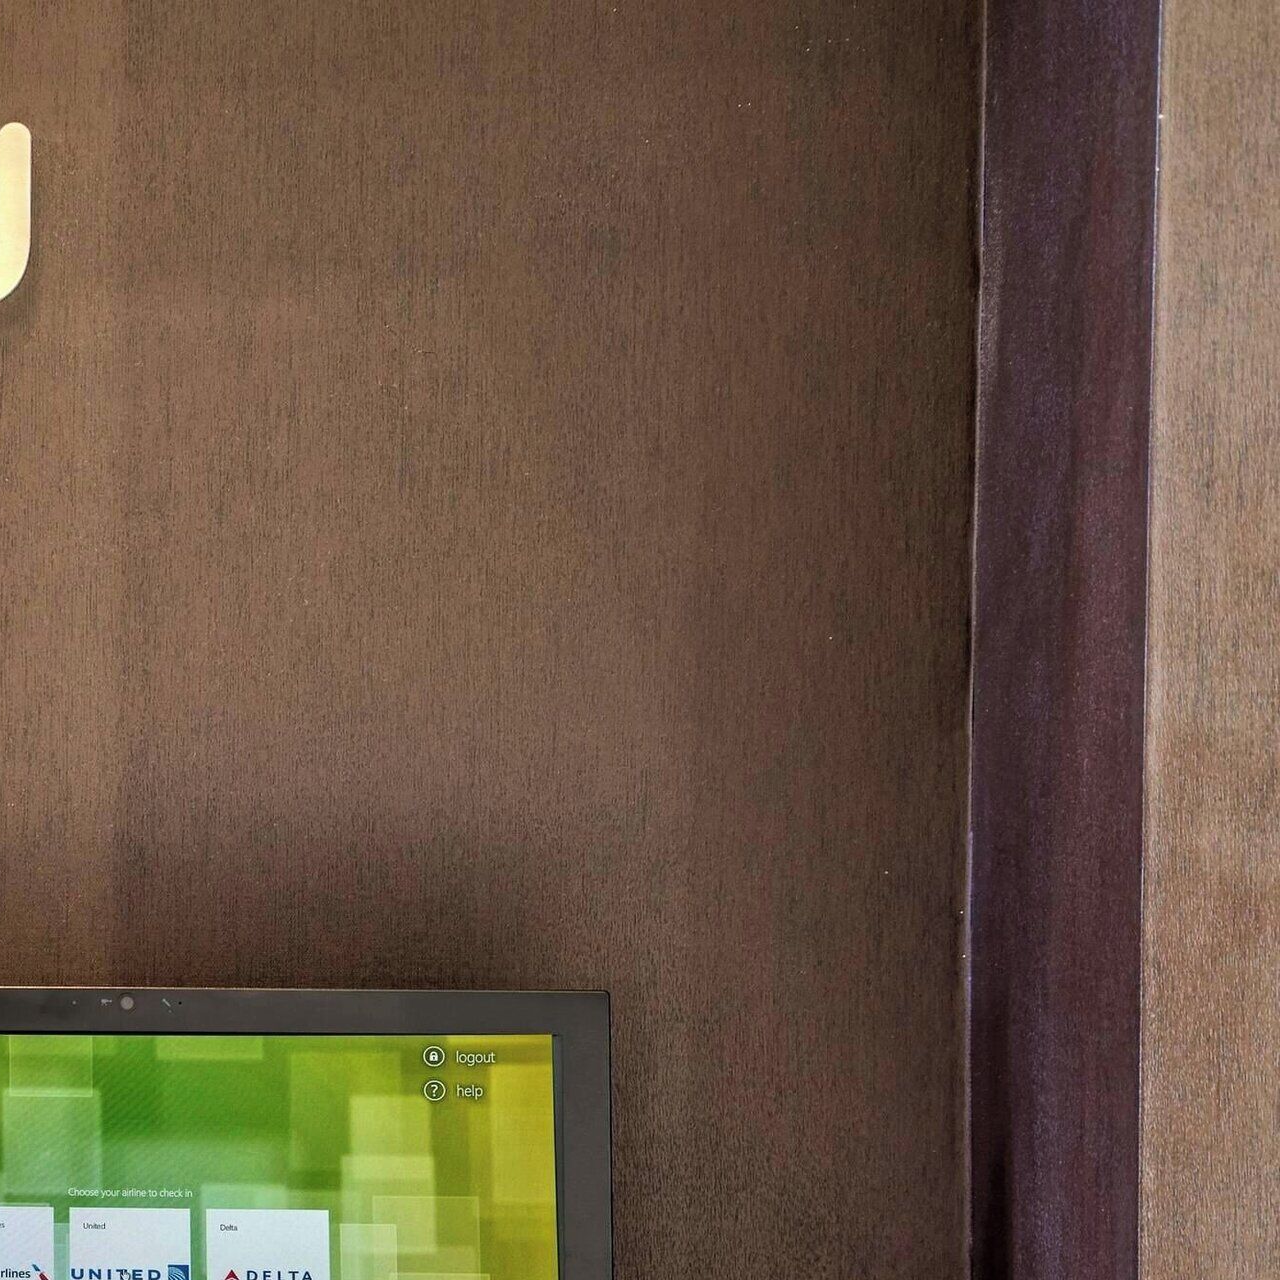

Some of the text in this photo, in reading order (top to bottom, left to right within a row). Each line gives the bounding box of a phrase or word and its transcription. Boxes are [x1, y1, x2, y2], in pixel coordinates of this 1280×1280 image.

[456, 1050, 496, 1066] logout
[456, 1084, 484, 1100] help
[67, 1187, 193, 1198] Choose your airline to check in
[83, 1222, 106, 1230] United
[219, 1223, 238, 1232] Delta
[70, 1267, 161, 1280] UNITED
